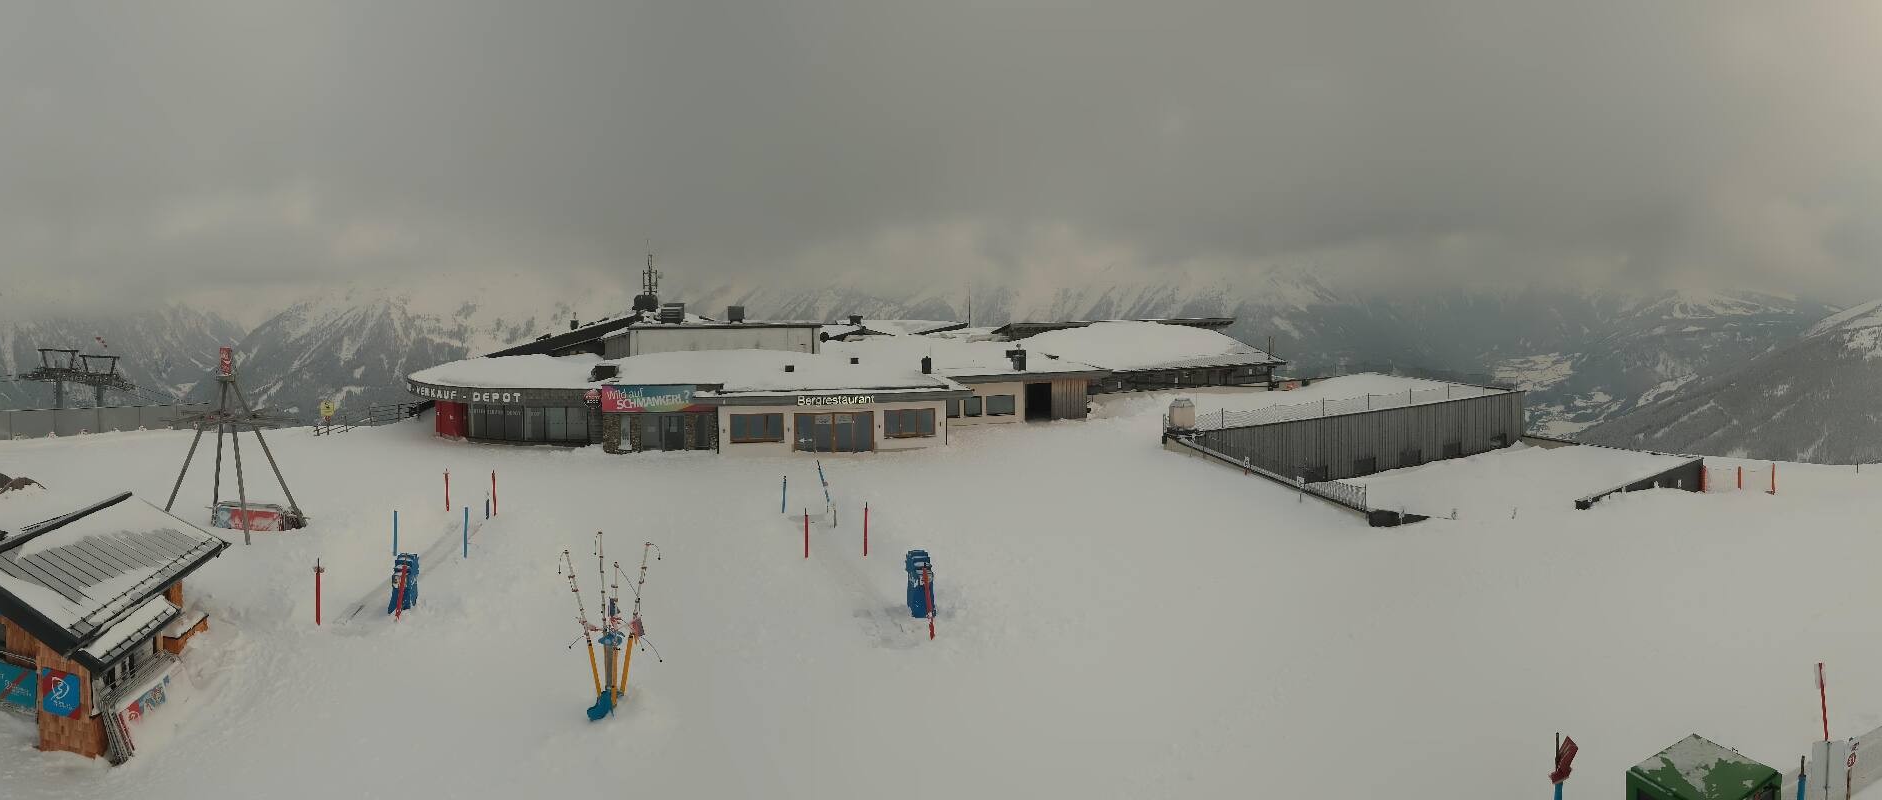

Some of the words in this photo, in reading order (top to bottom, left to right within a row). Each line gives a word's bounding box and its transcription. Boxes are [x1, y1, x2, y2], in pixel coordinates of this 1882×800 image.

[416, 385, 457, 400] VERKAUF
[472, 391, 521, 403] DEPOT
[606, 388, 627, 400] Wild
[628, 387, 643, 398] auf
[797, 394, 875, 407] Bergrestaurant
